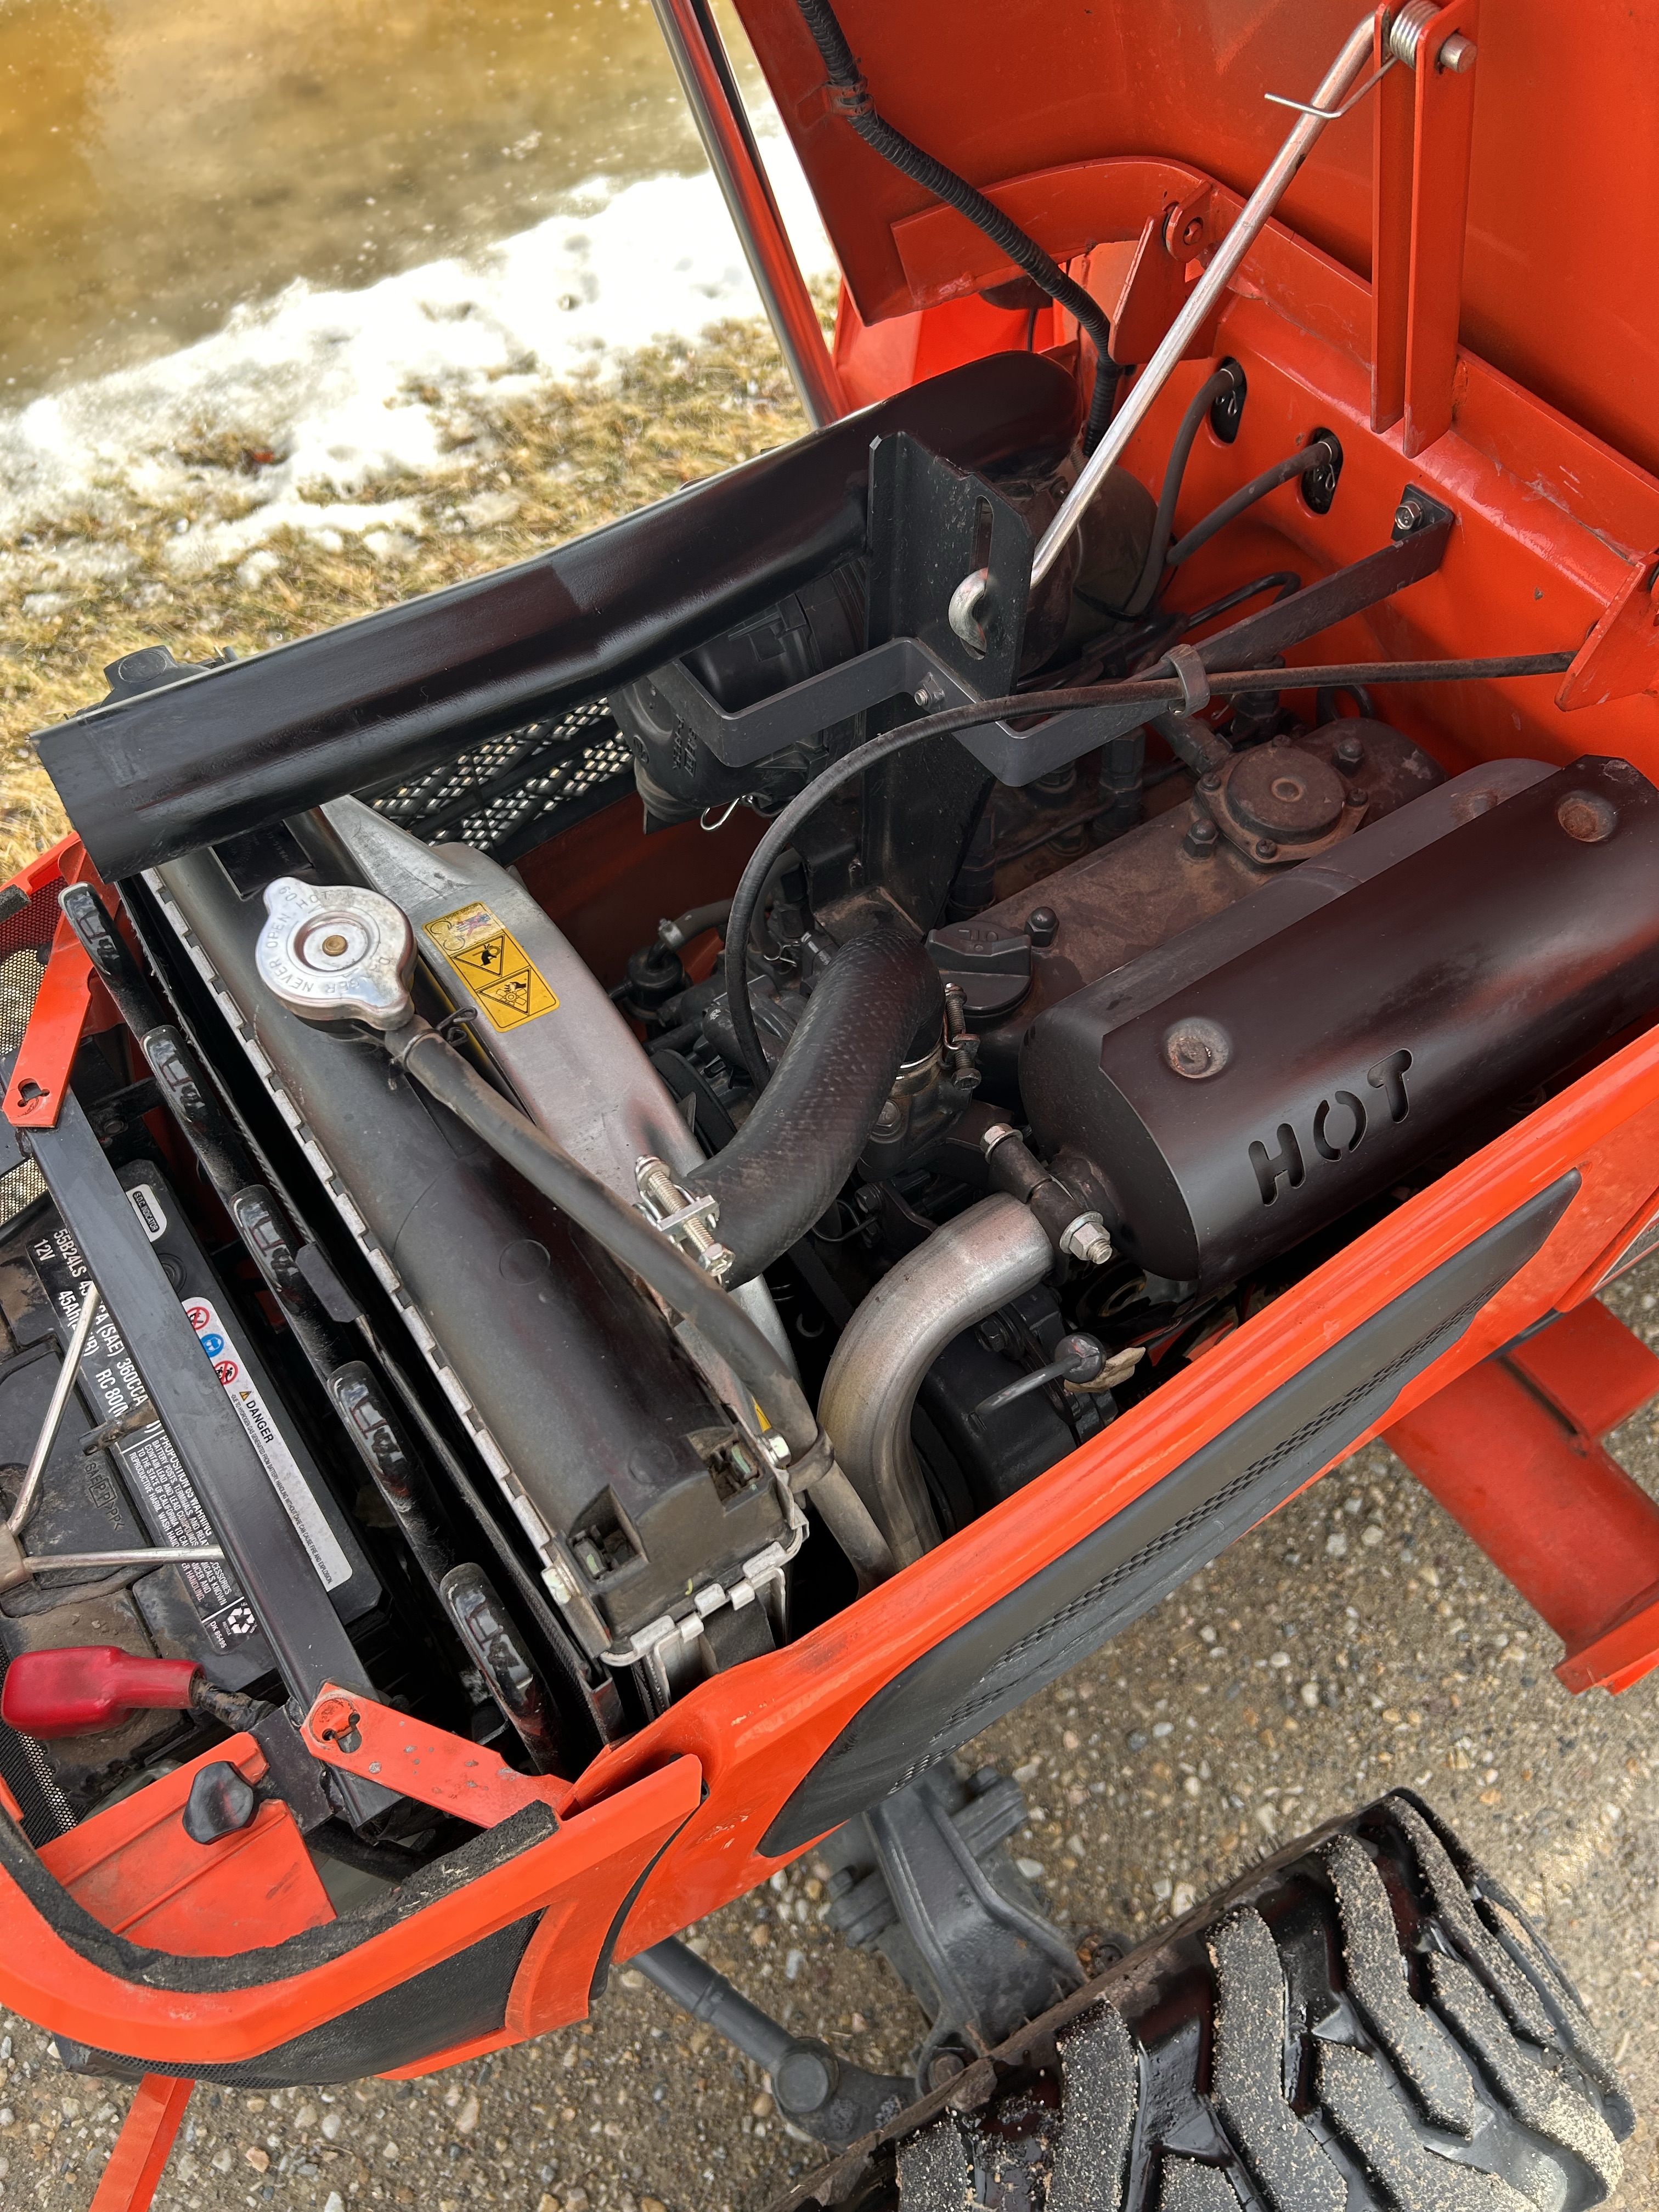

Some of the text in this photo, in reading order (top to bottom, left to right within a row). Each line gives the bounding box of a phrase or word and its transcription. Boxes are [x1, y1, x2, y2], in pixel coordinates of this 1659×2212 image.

[295, 889, 332, 910] HOT
[266, 913, 291, 949] OPEN
[269, 957, 314, 993] NEVER
[1248, 1048, 1414, 1207] HOT
[140, 1205, 159, 1232] INDICATOR
[52, 1227, 87, 1278] 55B24LS
[32, 1237, 56, 1263] 12V
[94, 1368, 117, 1390] RC
[94, 1321, 151, 1407] (SAE) 360CCA
[245, 1400, 275, 1443] DANGER
[136, 1447, 146, 1458] TO
[140, 1456, 152, 1470] THE
[128, 1451, 154, 1494] REPRODUCTIVE
[157, 1511, 172, 1532] WASH
[145, 1467, 160, 1487] STATE
[151, 1439, 169, 1465] BATTERY
[188, 1516, 200, 1530] AND
[154, 1485, 164, 1495] OF
[236, 1406, 251, 1427] HYDROGEN
[250, 1432, 266, 1455] GENERATED
[284, 1497, 297, 1515] WITHOUT
[302, 1531, 314, 1546] CAUSE
[313, 1553, 323, 1563] AND
[144, 1443, 161, 1469] CONTAIN
[155, 1467, 168, 1483] LEAD
[162, 1482, 174, 1497] AND
[168, 1494, 182, 1511] LEAD
[210, 1581, 228, 1606] KNOWN
[158, 1493, 180, 1527] CALIFORNIA
[173, 1526, 184, 1536] TO
[199, 1579, 212, 1594] AND
[209, 1620, 228, 1649] DK 85495
